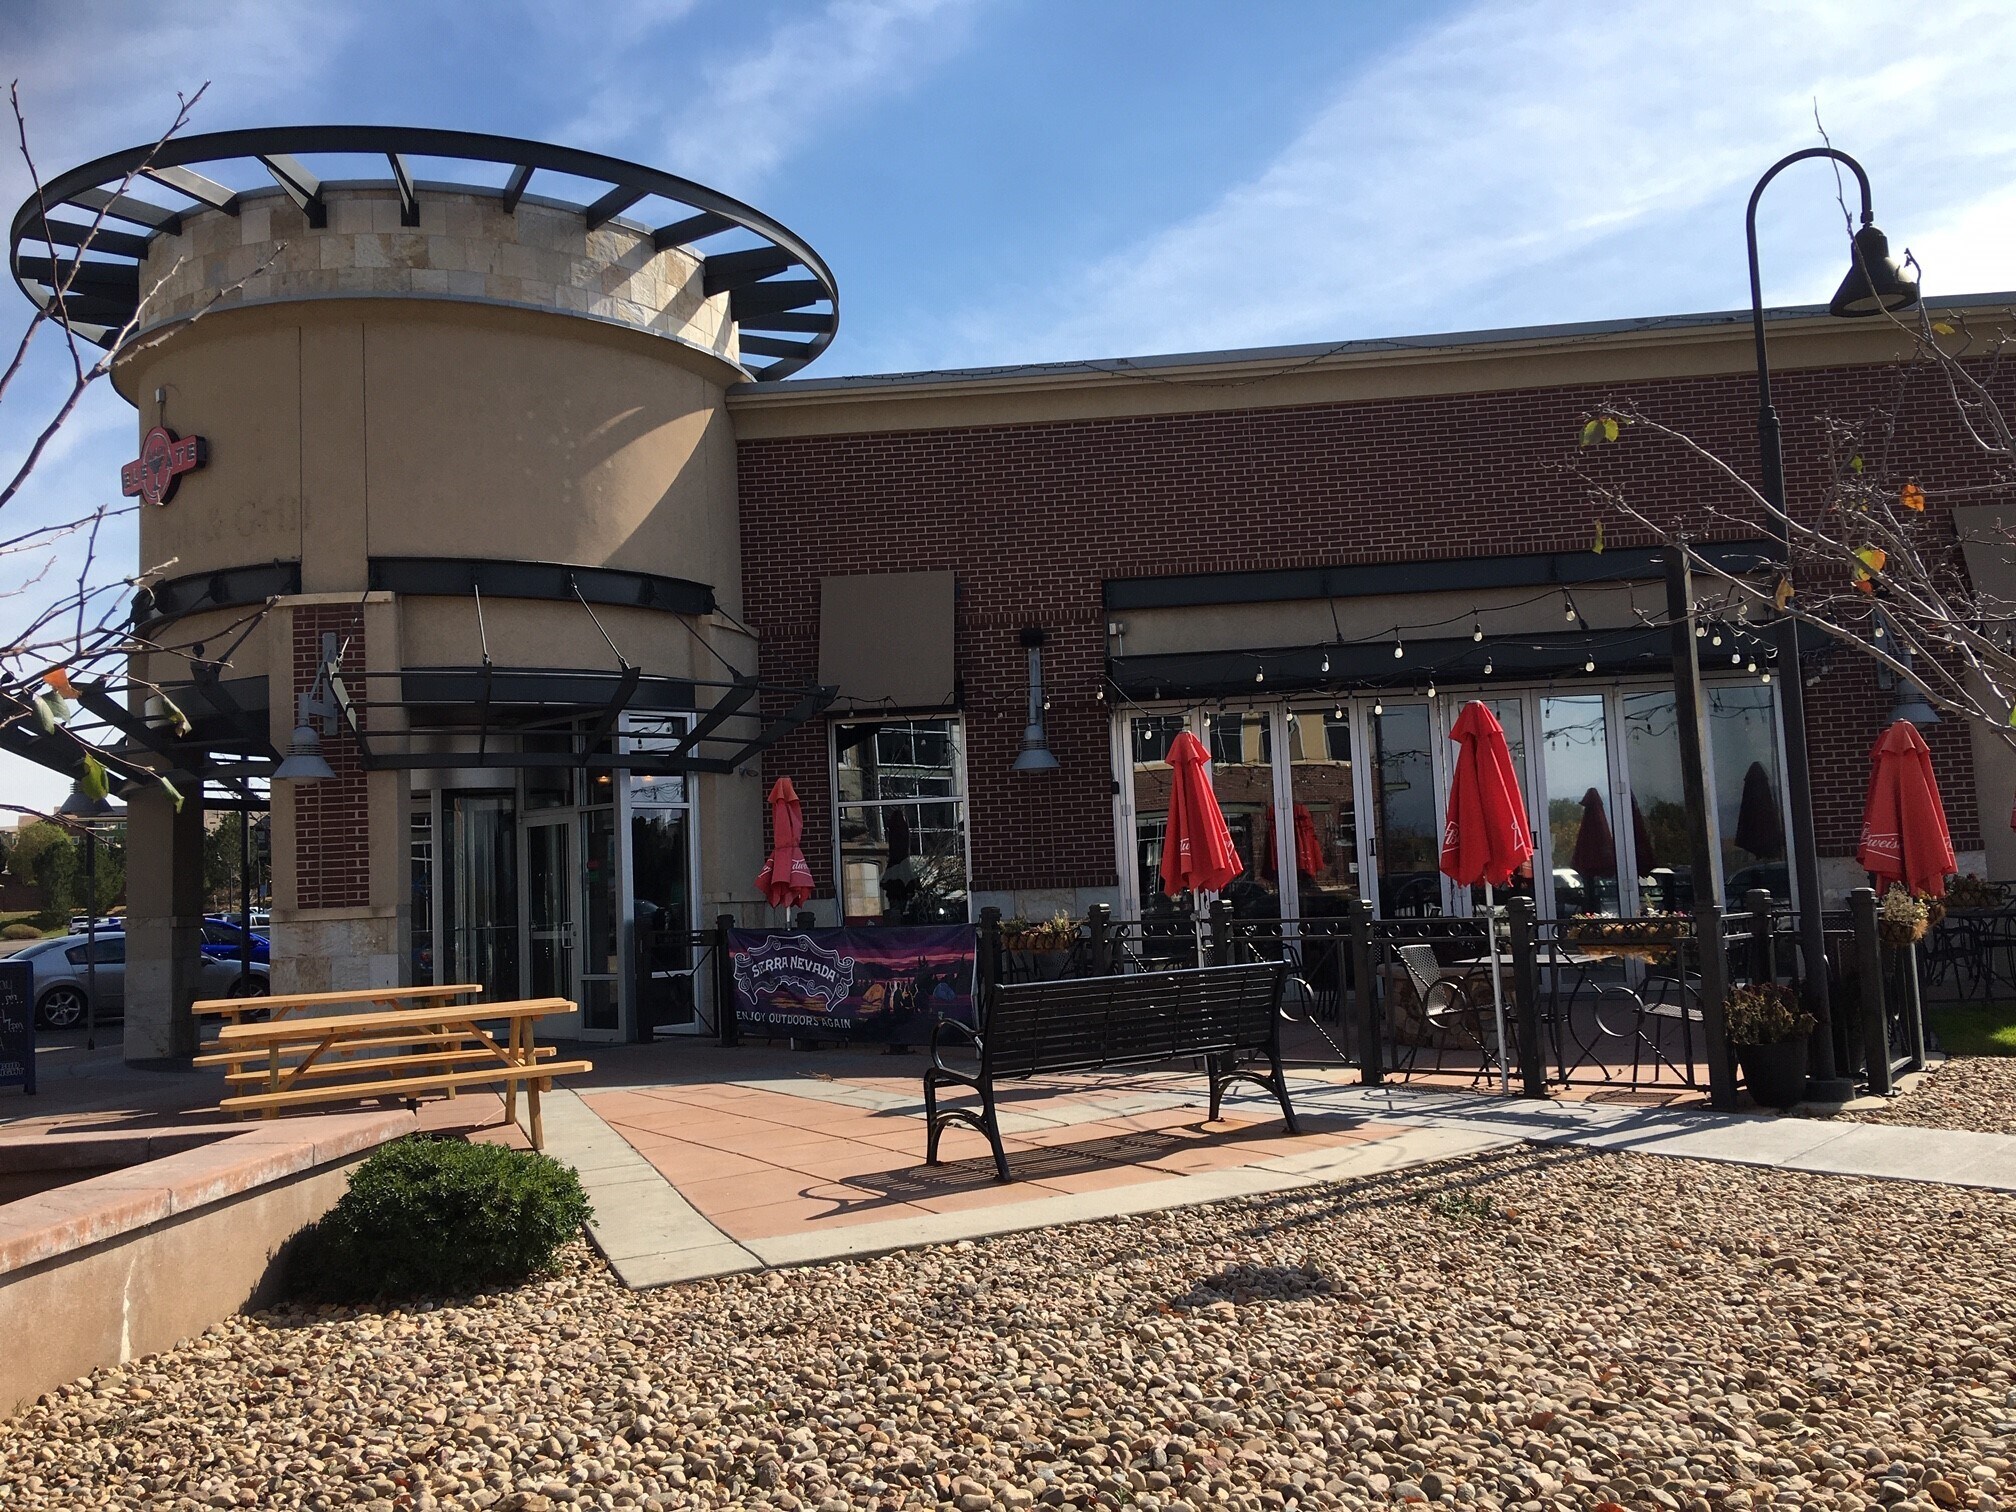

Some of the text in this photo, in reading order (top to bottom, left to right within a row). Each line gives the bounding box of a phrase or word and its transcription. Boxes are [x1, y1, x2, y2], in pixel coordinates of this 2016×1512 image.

[751, 955, 837, 983] SIERRA NEVADA
[736, 1010, 852, 1030] ENJOY OUTDOORS AGAIN
